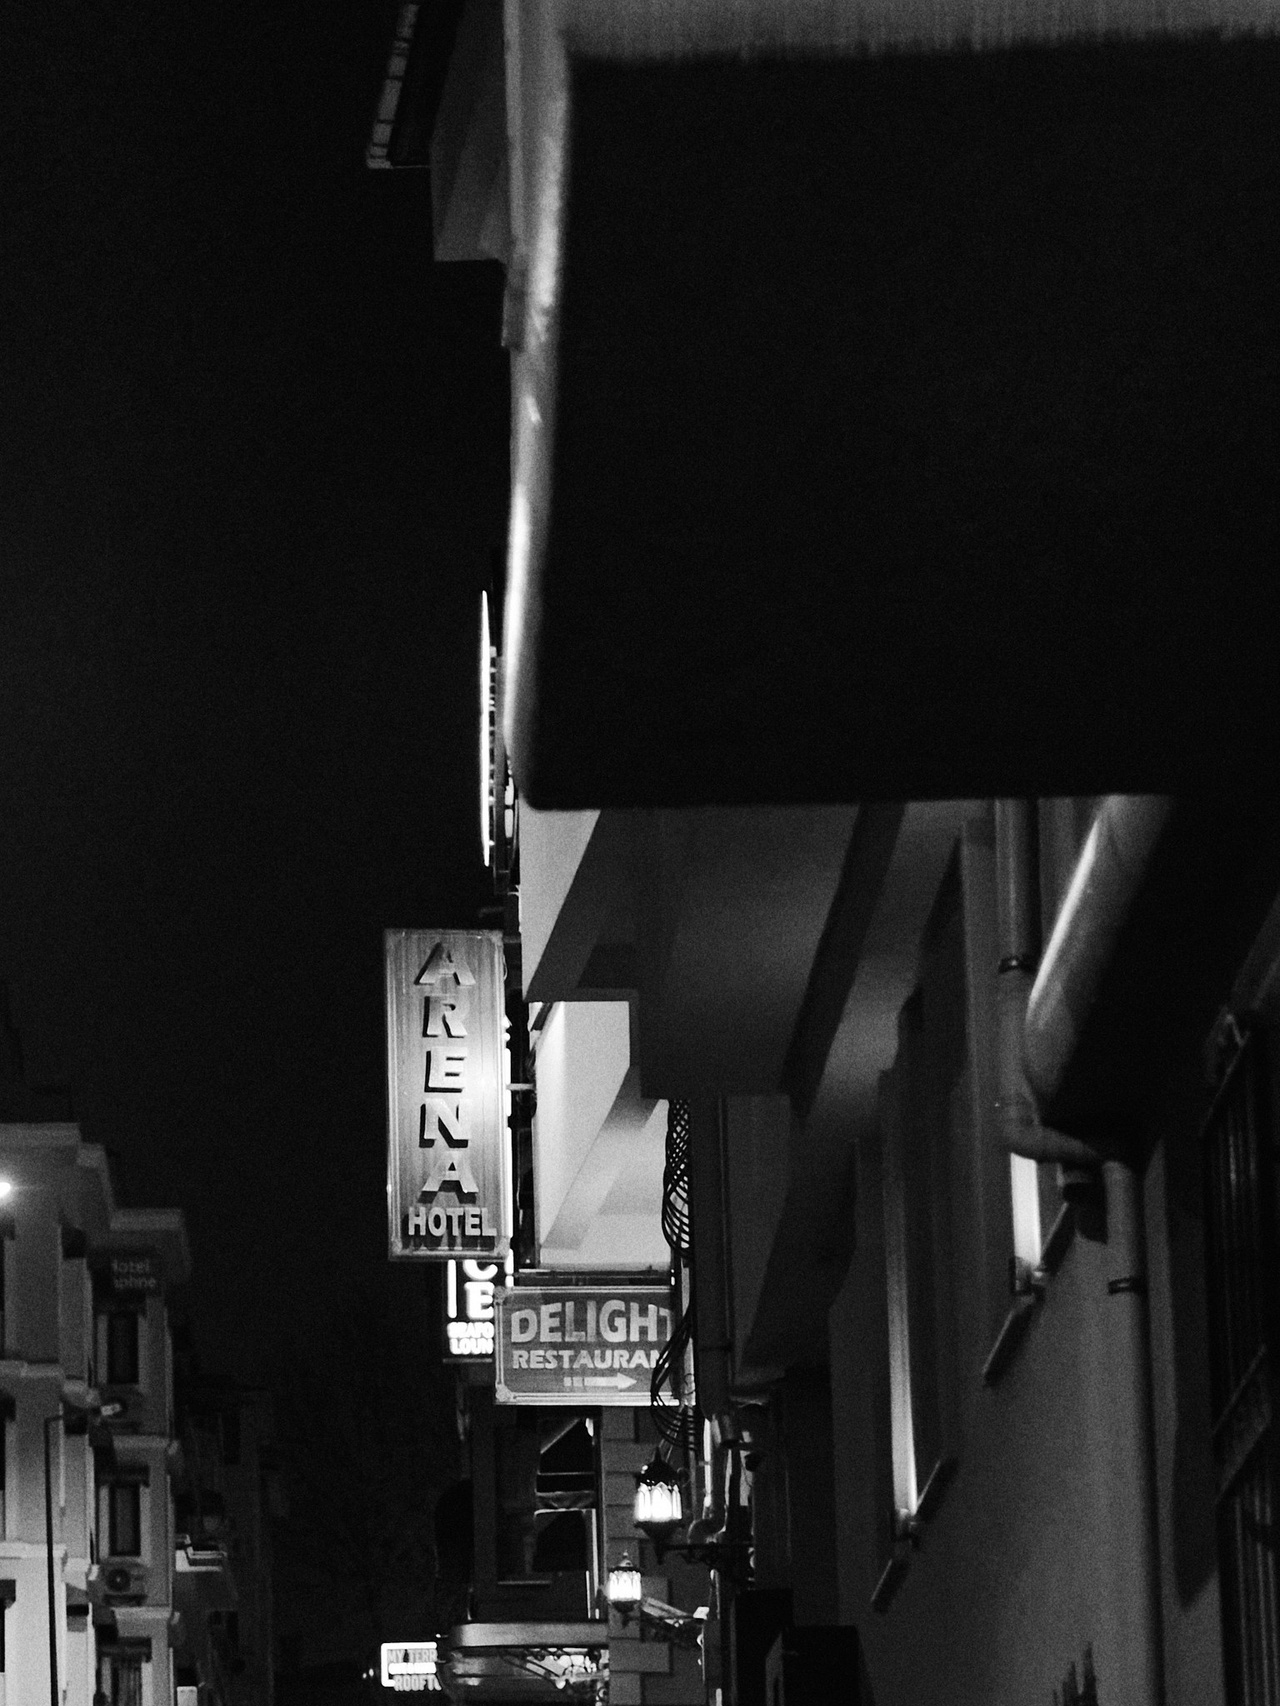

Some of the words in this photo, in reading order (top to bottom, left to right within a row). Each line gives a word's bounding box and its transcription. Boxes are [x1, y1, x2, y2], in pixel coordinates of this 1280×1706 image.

[416, 941, 479, 1198] ARENA
[408, 1206, 498, 1237] HOTEL
[511, 1300, 673, 1343] DELIGHT
[512, 1349, 662, 1370] RESTAURAN
